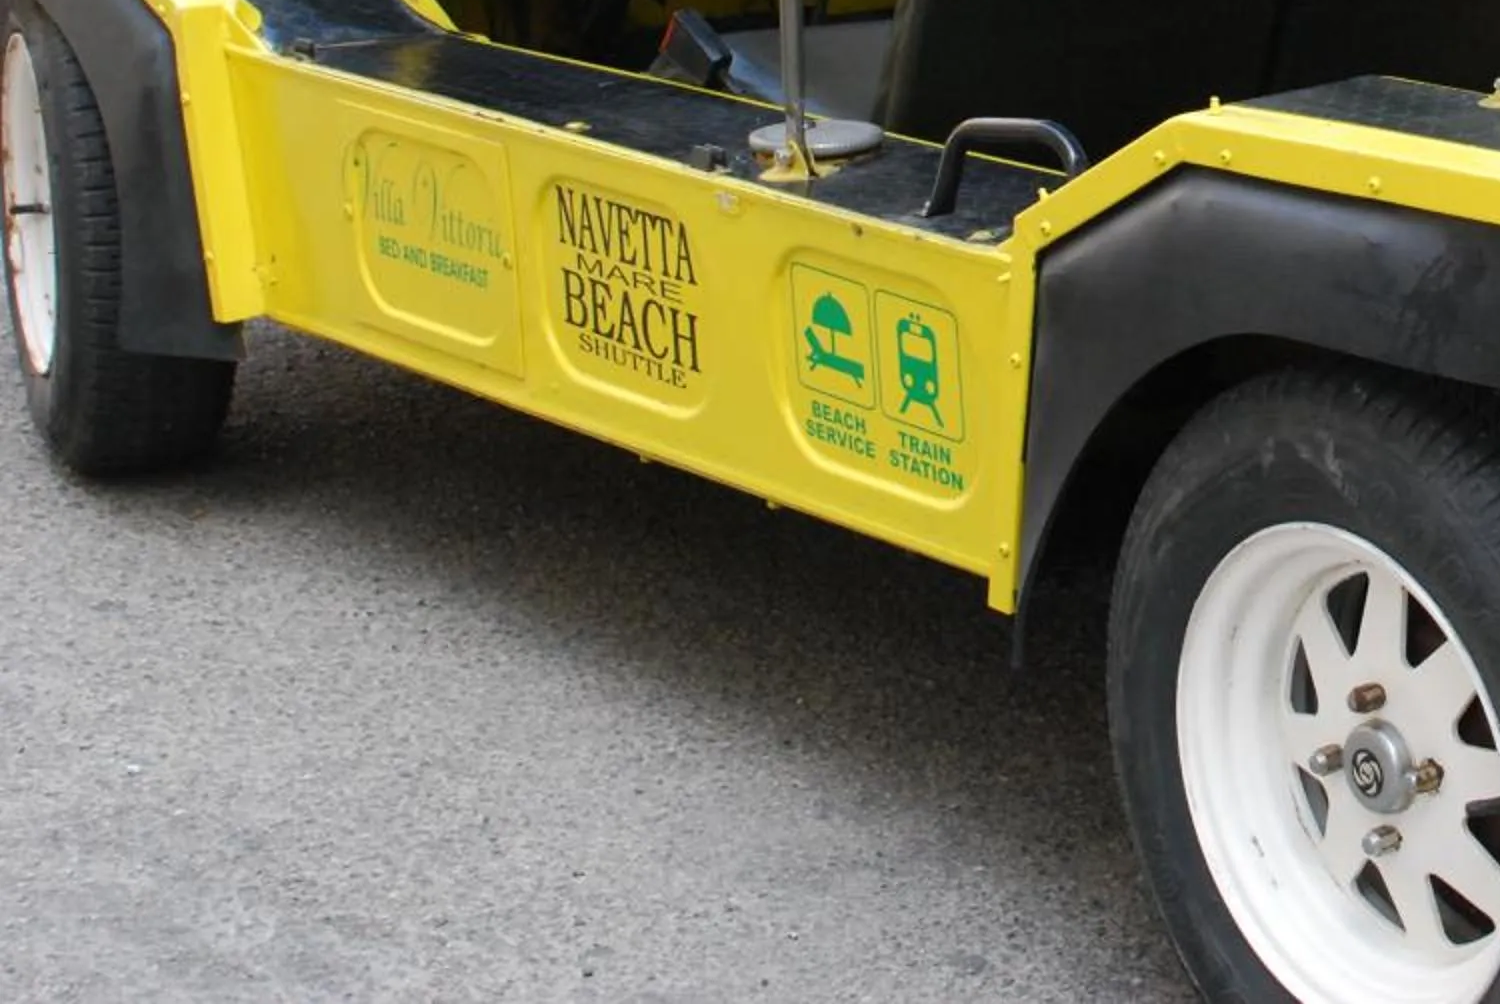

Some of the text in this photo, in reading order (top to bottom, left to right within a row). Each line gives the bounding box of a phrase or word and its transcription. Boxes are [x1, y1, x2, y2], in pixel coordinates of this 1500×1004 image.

[379, 234, 489, 289] BED AND BREAKFAST
[555, 184, 698, 286] NAVETTA
[577, 252, 683, 305] MARE
[561, 267, 702, 374] BEACH
[578, 332, 687, 389] SHUTTLE
[804, 419, 877, 459] SERVICE
[811, 400, 867, 435] BEACH
[889, 449, 965, 491] STATION
[898, 431, 952, 466] TRAIN
